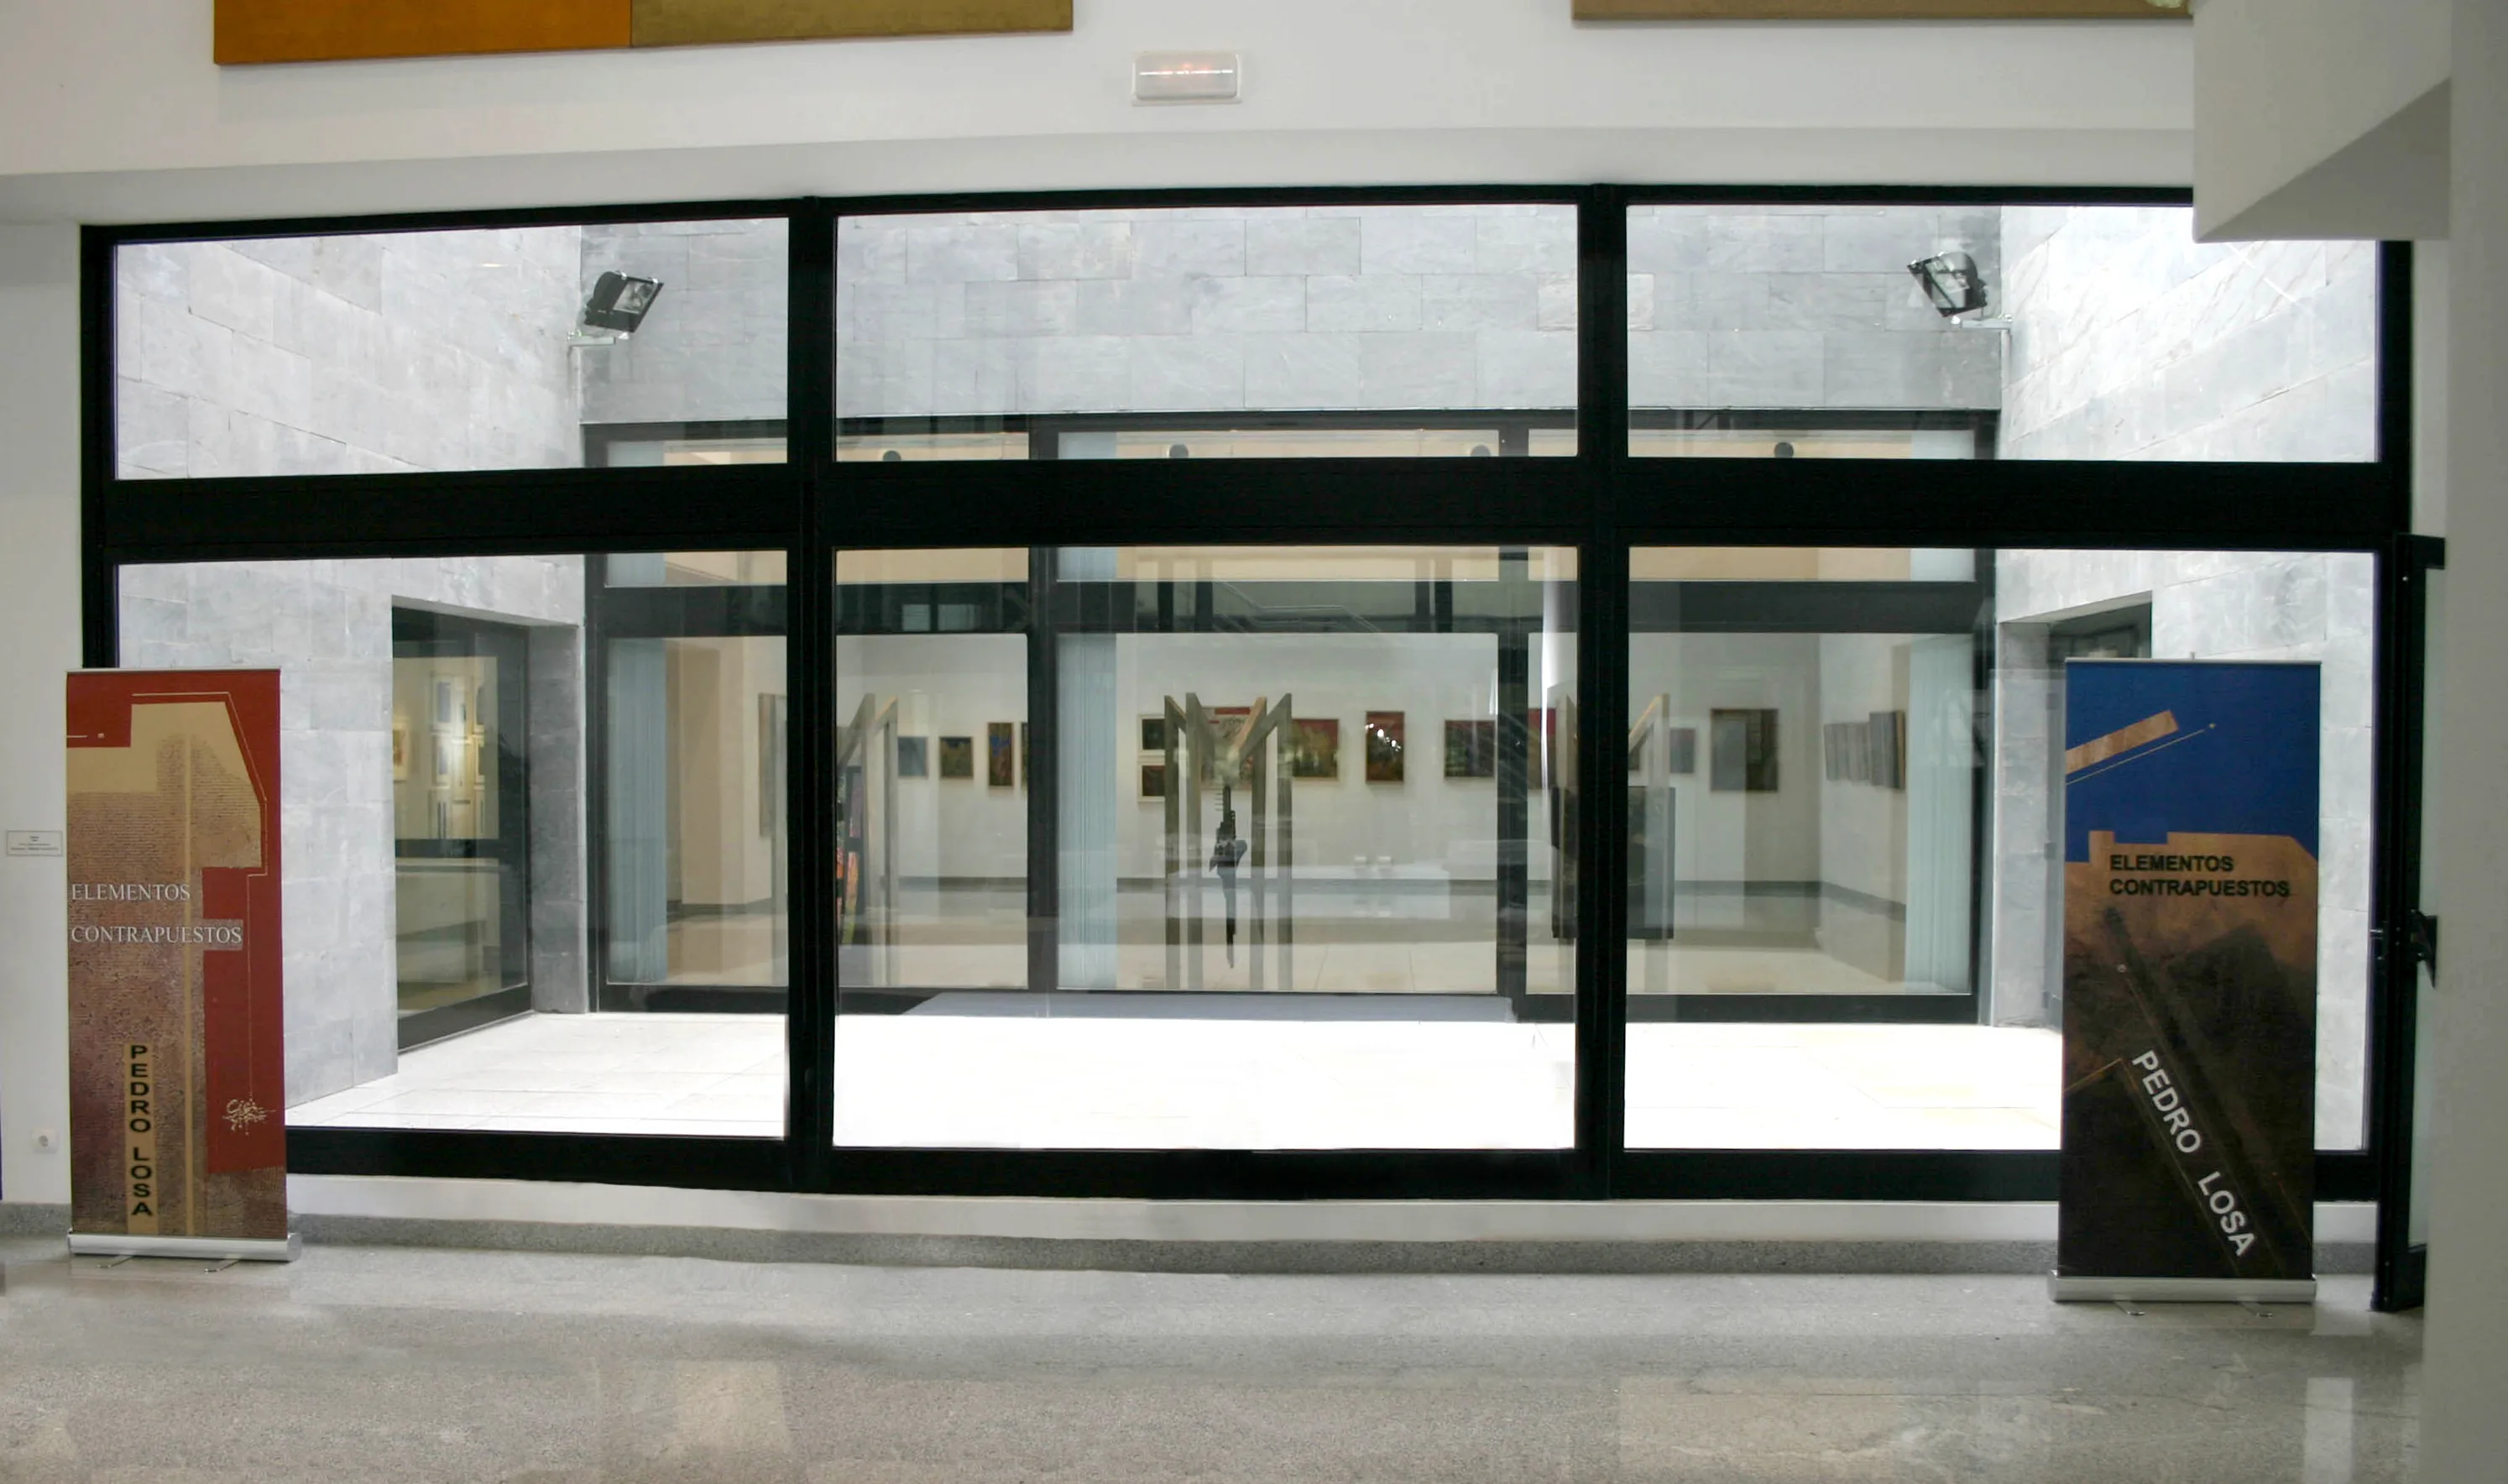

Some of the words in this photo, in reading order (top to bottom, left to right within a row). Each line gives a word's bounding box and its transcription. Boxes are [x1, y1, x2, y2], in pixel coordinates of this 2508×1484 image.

[2110, 854, 2234, 871] ELEMENTOS
[71, 884, 191, 901] ELEMENTOS
[2110, 879, 2290, 896] CONTRAPUESTOS
[71, 927, 242, 943] CONTRAPUESTOS
[130, 1045, 151, 1132] PEDRO
[2132, 1050, 2202, 1153] PEDRO
[2197, 1171, 2256, 1257] LOSA
[131, 1147, 152, 1215] LOSA
